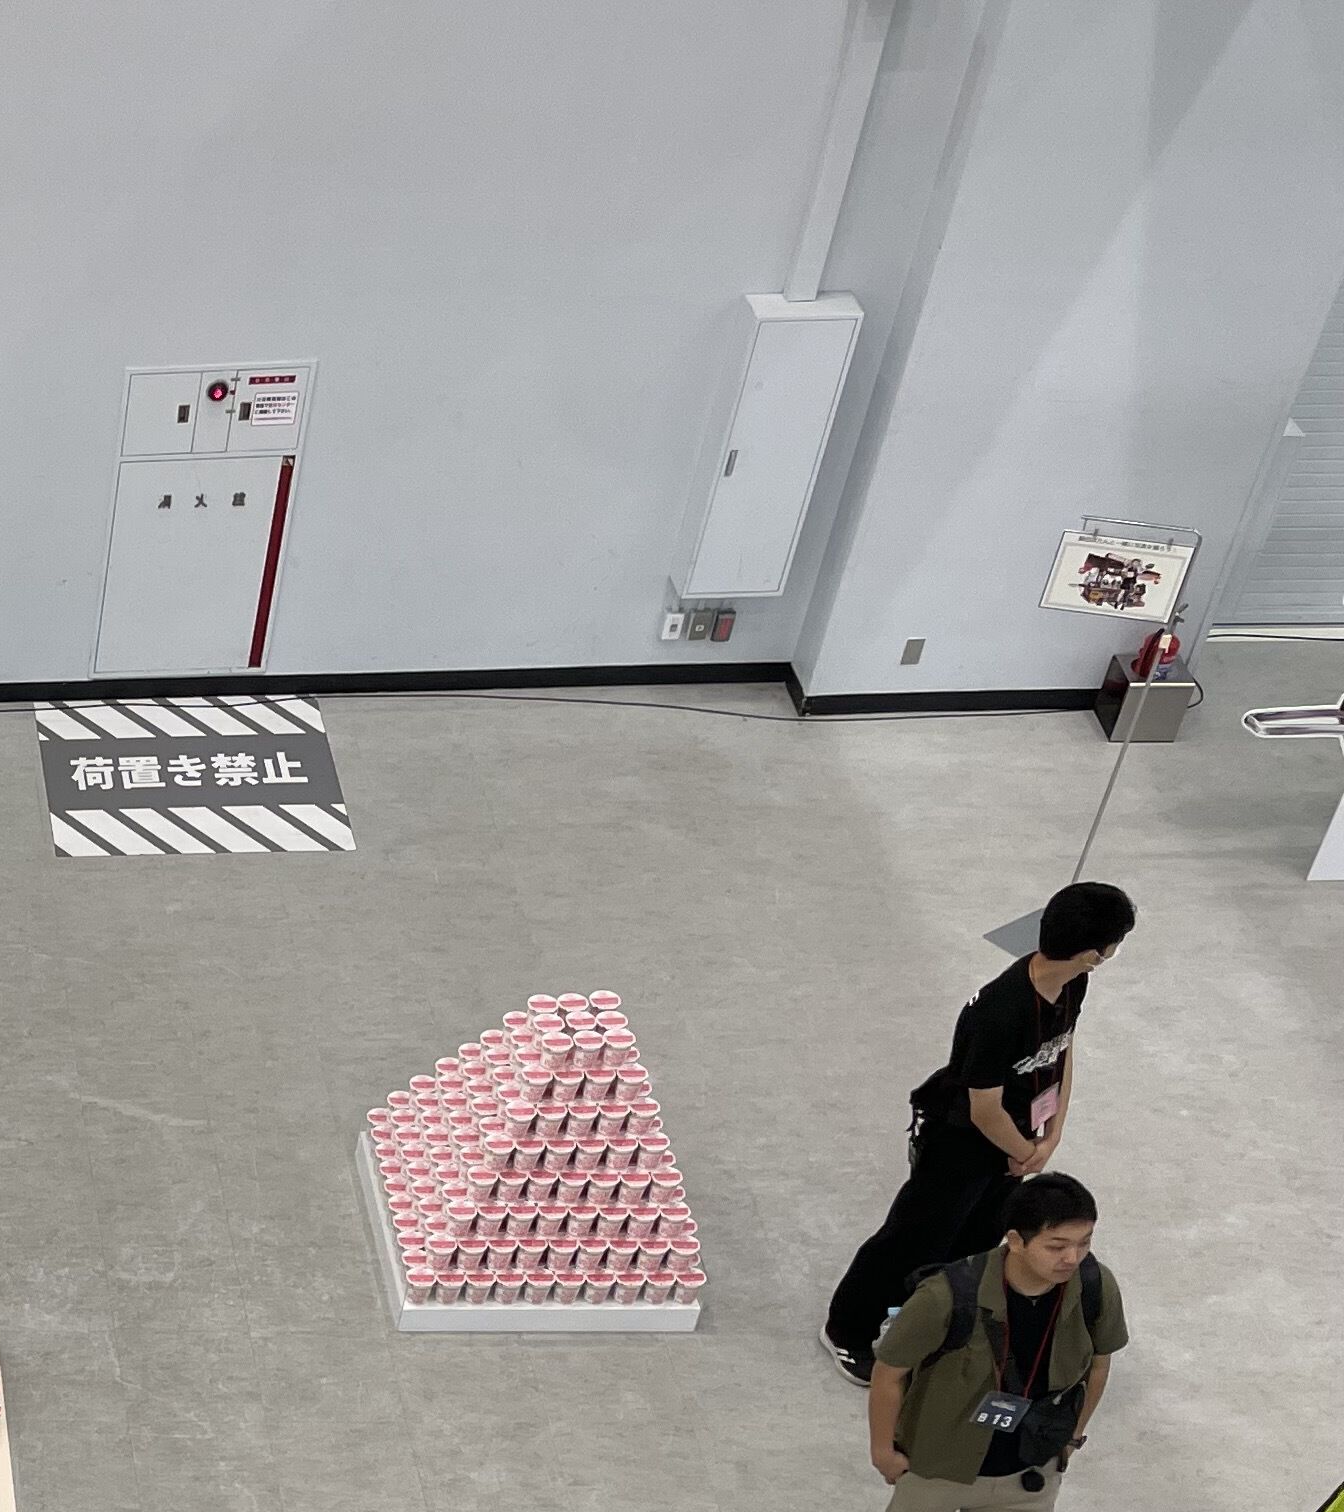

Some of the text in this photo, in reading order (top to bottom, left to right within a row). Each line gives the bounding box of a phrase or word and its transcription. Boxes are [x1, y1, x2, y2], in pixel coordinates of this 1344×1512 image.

[69, 752, 309, 791] 荷置き禁止
[992, 1413, 1013, 1428] 13
